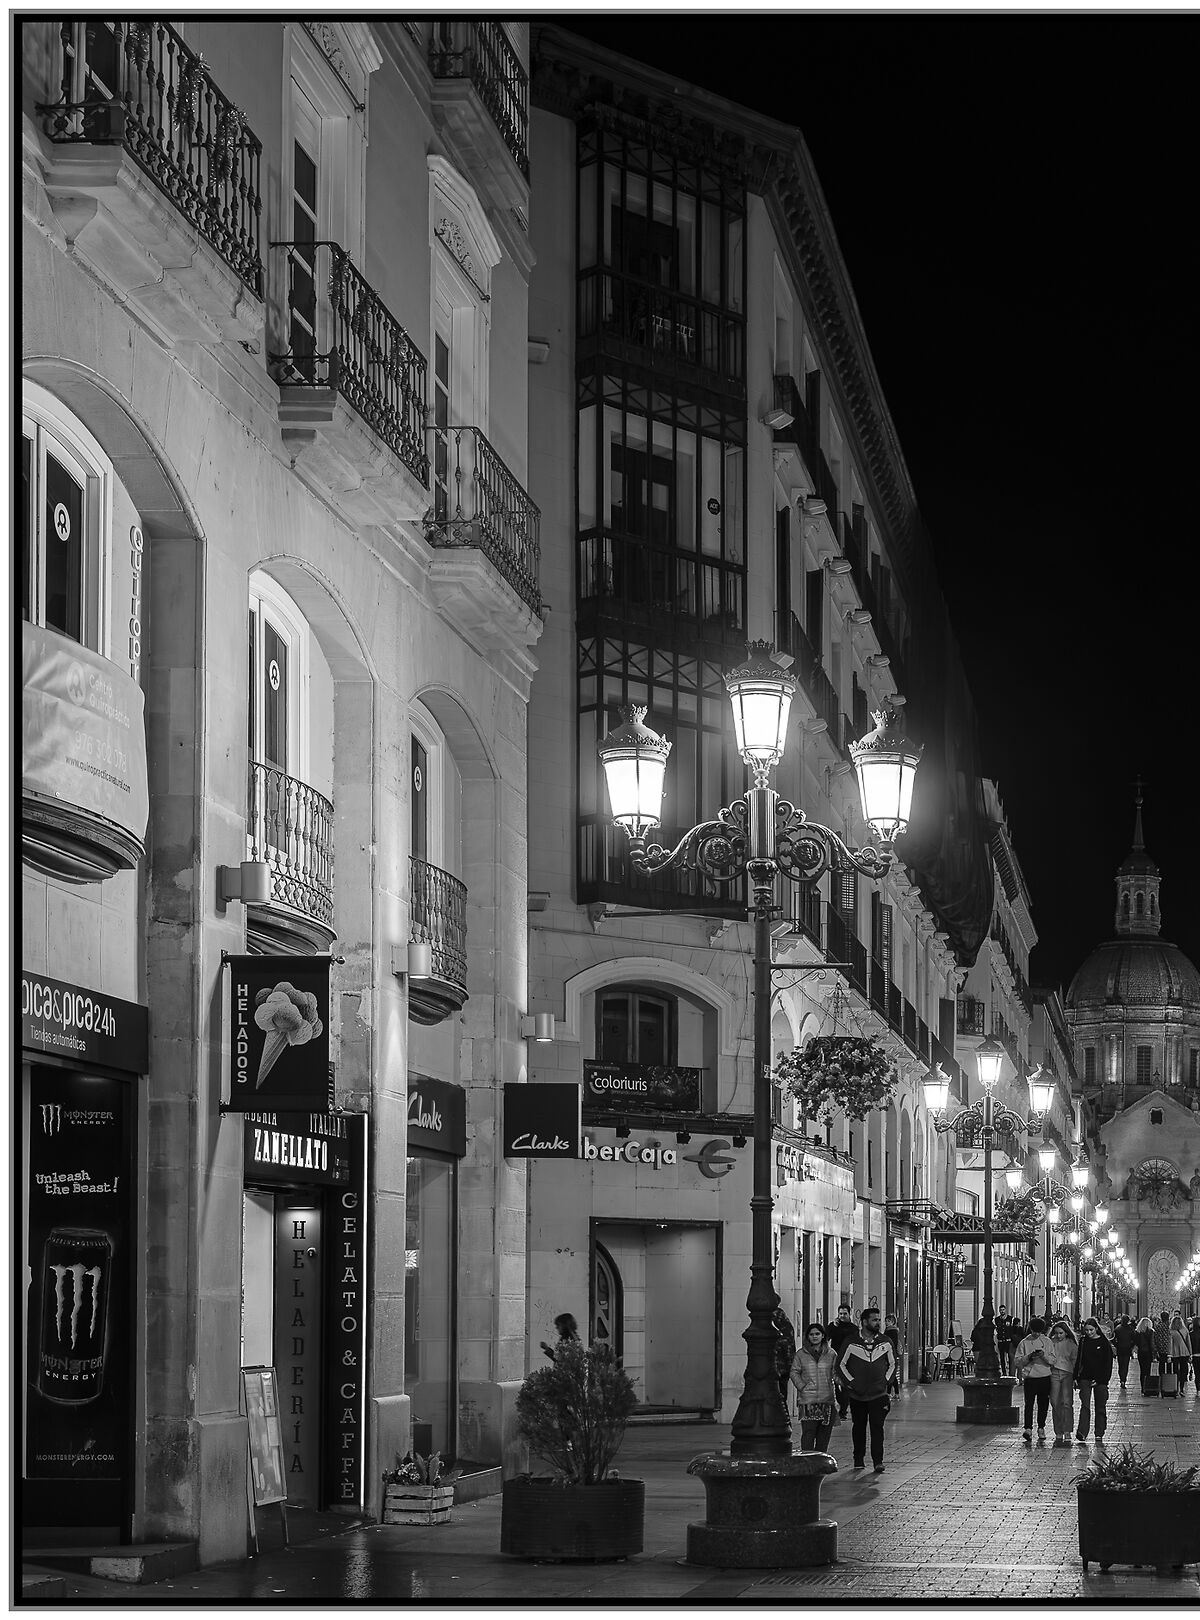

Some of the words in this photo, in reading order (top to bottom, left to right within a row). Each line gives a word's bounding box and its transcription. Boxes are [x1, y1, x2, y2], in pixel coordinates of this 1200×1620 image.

[30, 1024, 52, 1044] Tiendas
[52, 1035, 87, 1052] automáticas
[237, 984, 248, 1083] HELADOS
[594, 1075, 648, 1091] coloriuris
[64, 1110, 114, 1120] MONSTER
[407, 1091, 442, 1132] Clarks
[254, 1128, 328, 1171] ZANELLATO
[511, 1133, 571, 1150] Clarks
[35, 1169, 91, 1185] Unleash
[45, 1184, 70, 1195] the
[72, 1177, 119, 1193] Beast!
[341, 1192, 358, 1332] GELATO
[290, 1220, 307, 1473] HELADERÍA
[342, 1349, 356, 1366] &
[45, 1370, 97, 1380] ENERGY
[340, 1383, 357, 1498] CAFFÈ
